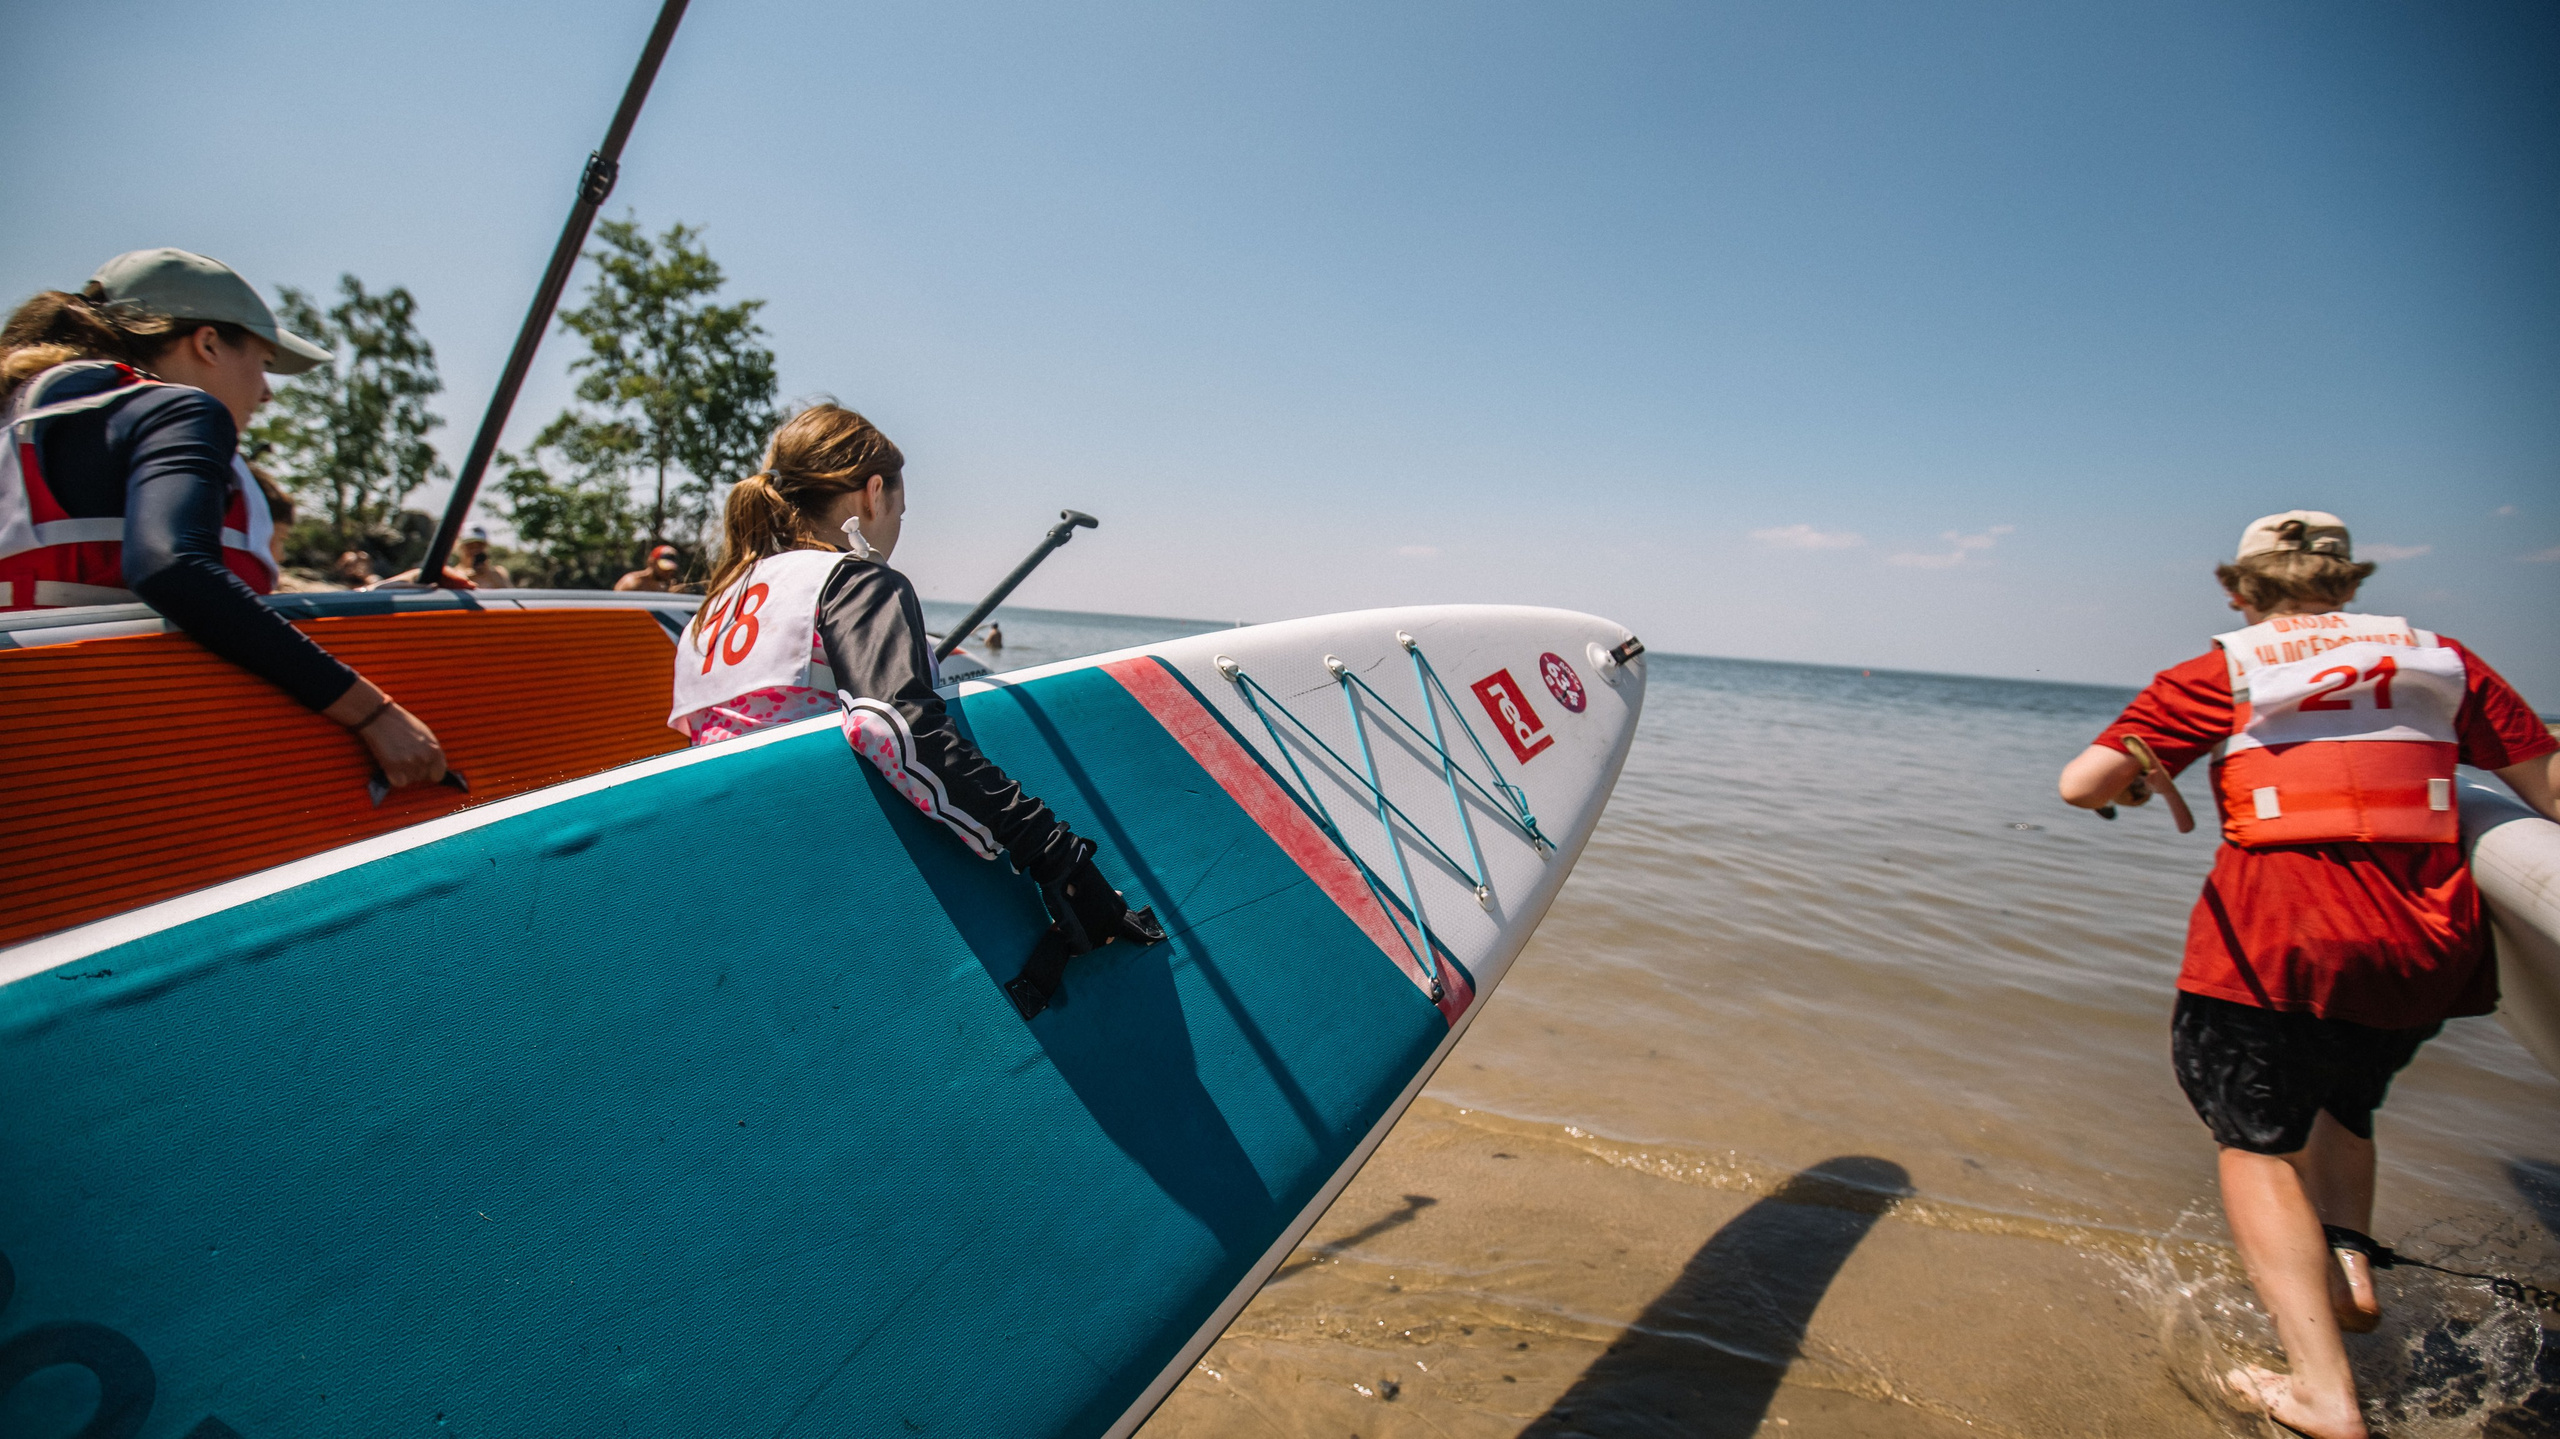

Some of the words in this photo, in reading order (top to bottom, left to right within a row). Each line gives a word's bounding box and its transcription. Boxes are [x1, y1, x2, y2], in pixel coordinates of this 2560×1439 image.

[700, 582, 770, 676] 18
[1486, 682, 1551, 751] red
[2297, 655, 2397, 713] 21
